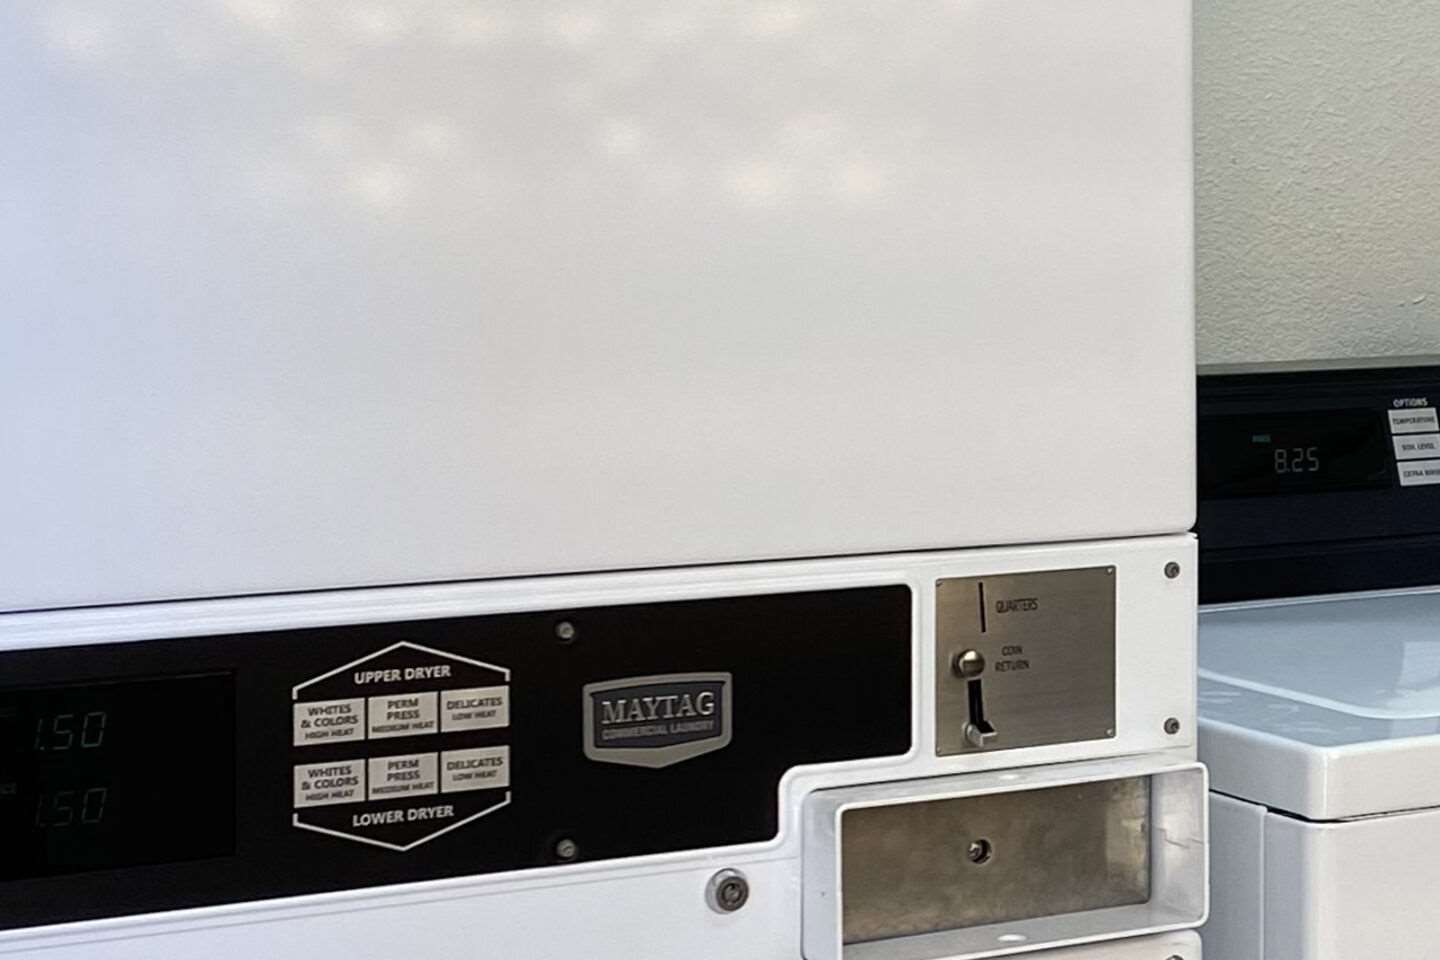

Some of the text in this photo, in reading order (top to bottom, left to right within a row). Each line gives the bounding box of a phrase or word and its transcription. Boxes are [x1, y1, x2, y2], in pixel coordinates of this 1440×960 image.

[1392, 397, 1428, 408] OPTIONS
[354, 664, 452, 685] UPPER DRYER
[307, 704, 352, 717] WHITES
[387, 698, 419, 710] PERM
[446, 697, 503, 711] DELICATES
[602, 691, 715, 725] MAYTAG
[314, 715, 359, 728] COLORS
[387, 710, 420, 720] PRESS
[330, 727, 355, 738] HEAT
[387, 759, 419, 771] PERM
[446, 757, 504, 771] DELICATES
[307, 765, 352, 779] WHITES
[387, 770, 420, 781] PRESS
[314, 776, 359, 790] COLORS
[330, 788, 355, 799] HEAT
[352, 805, 454, 827] LOWER DRYER
